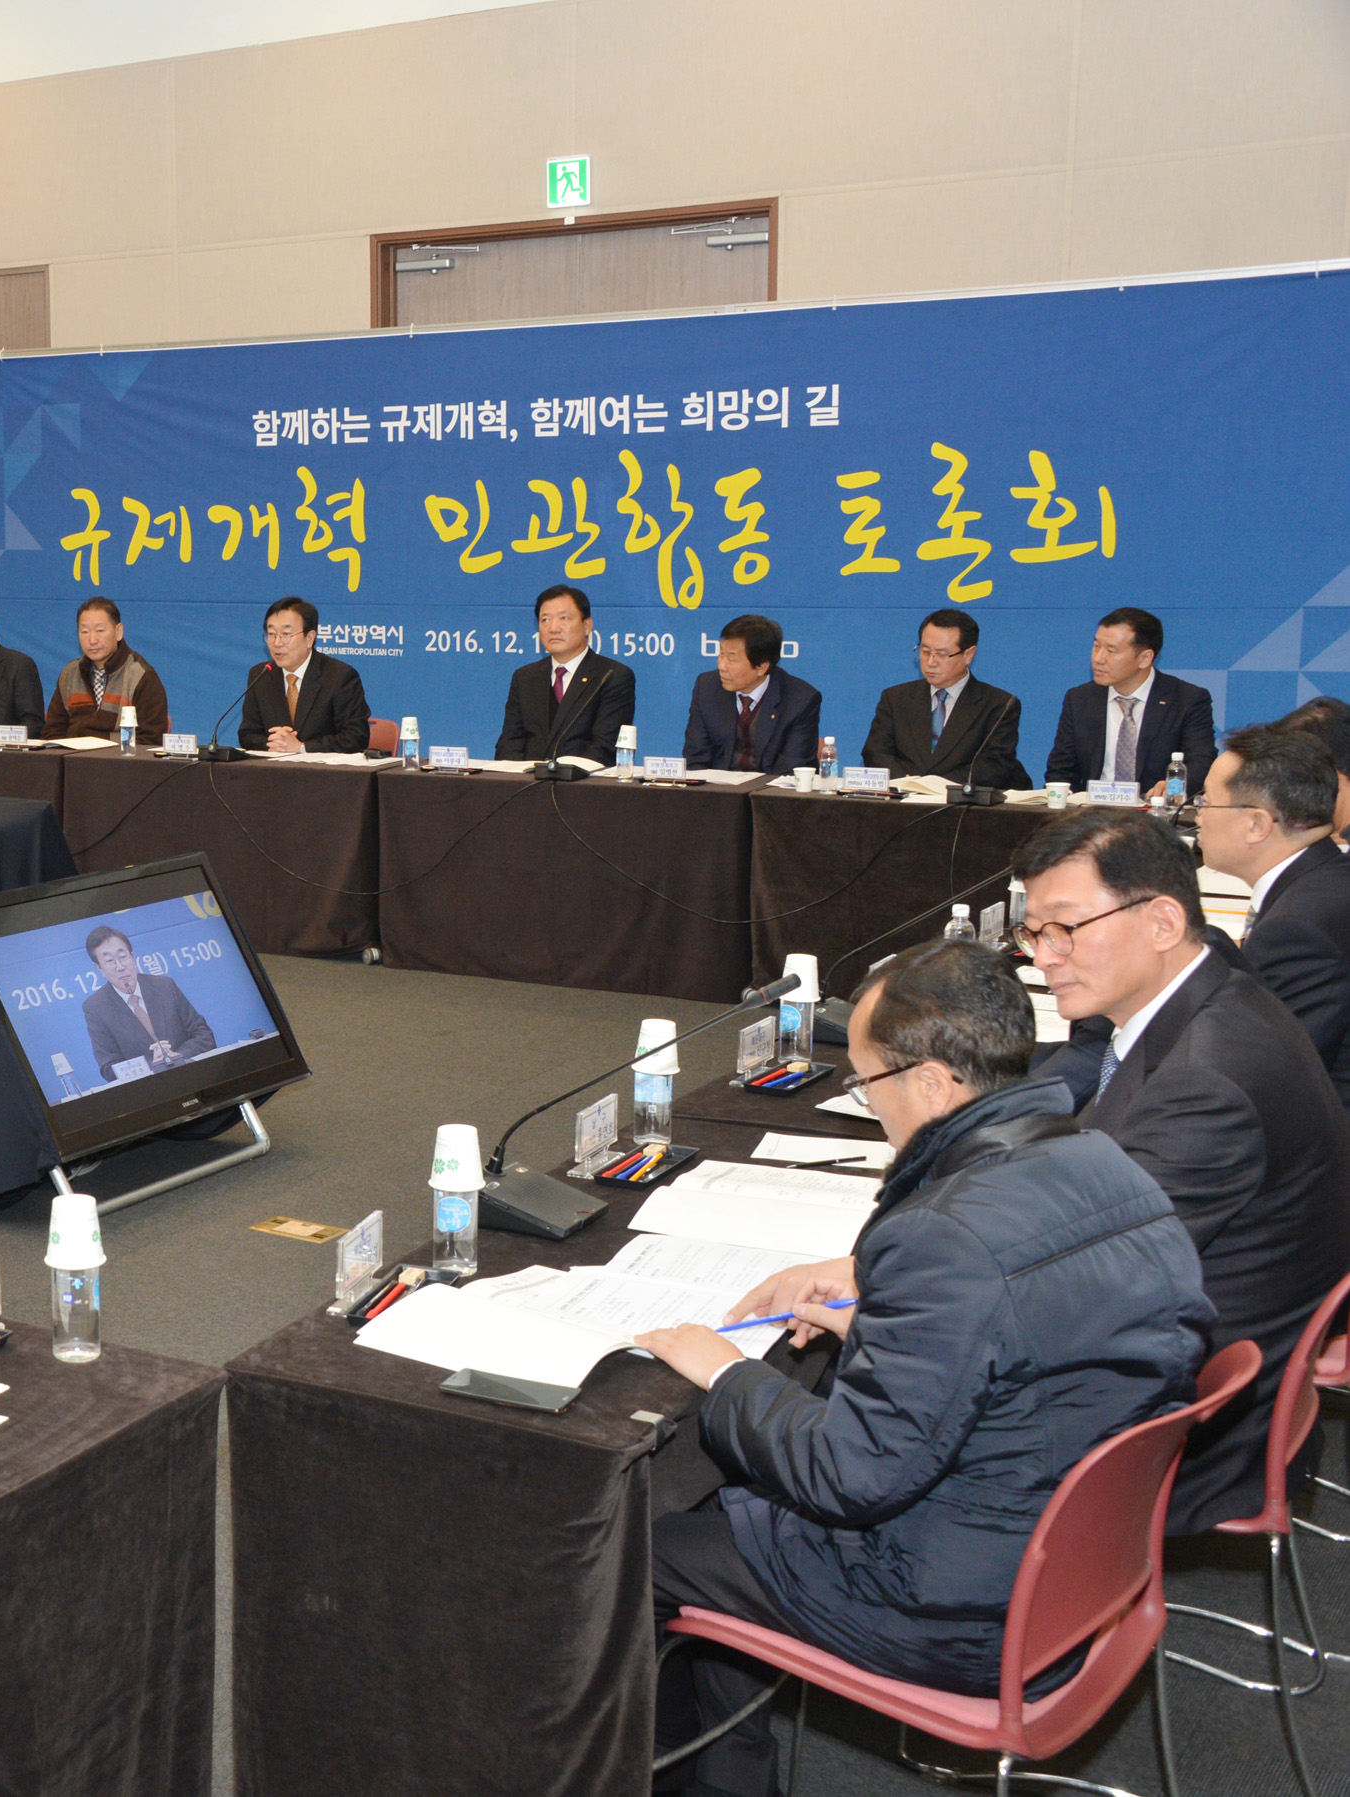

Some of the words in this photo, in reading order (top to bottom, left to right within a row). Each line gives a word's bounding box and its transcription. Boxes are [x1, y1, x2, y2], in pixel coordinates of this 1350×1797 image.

[252, 406, 371, 447] 함께하는
[379, 400, 518, 443] 규제개혁,
[530, 394, 668, 438] 함께여는
[681, 387, 790, 432] 희망의
[805, 384, 840, 427] 길
[61, 466, 367, 593] 규제개혁
[424, 449, 771, 610] 민관합동
[837, 442, 1117, 603] 토론회
[317, 624, 404, 645] 부산광역시
[338, 647, 387, 656] METROPOLITAN
[388, 648, 404, 656] CITY
[424, 629, 484, 654] 2016.
[491, 630, 524, 655] 12.
[609, 632, 675, 657] 15:00
[11, 978, 74, 1011] 2016.
[170, 938, 223, 969] 15:00
